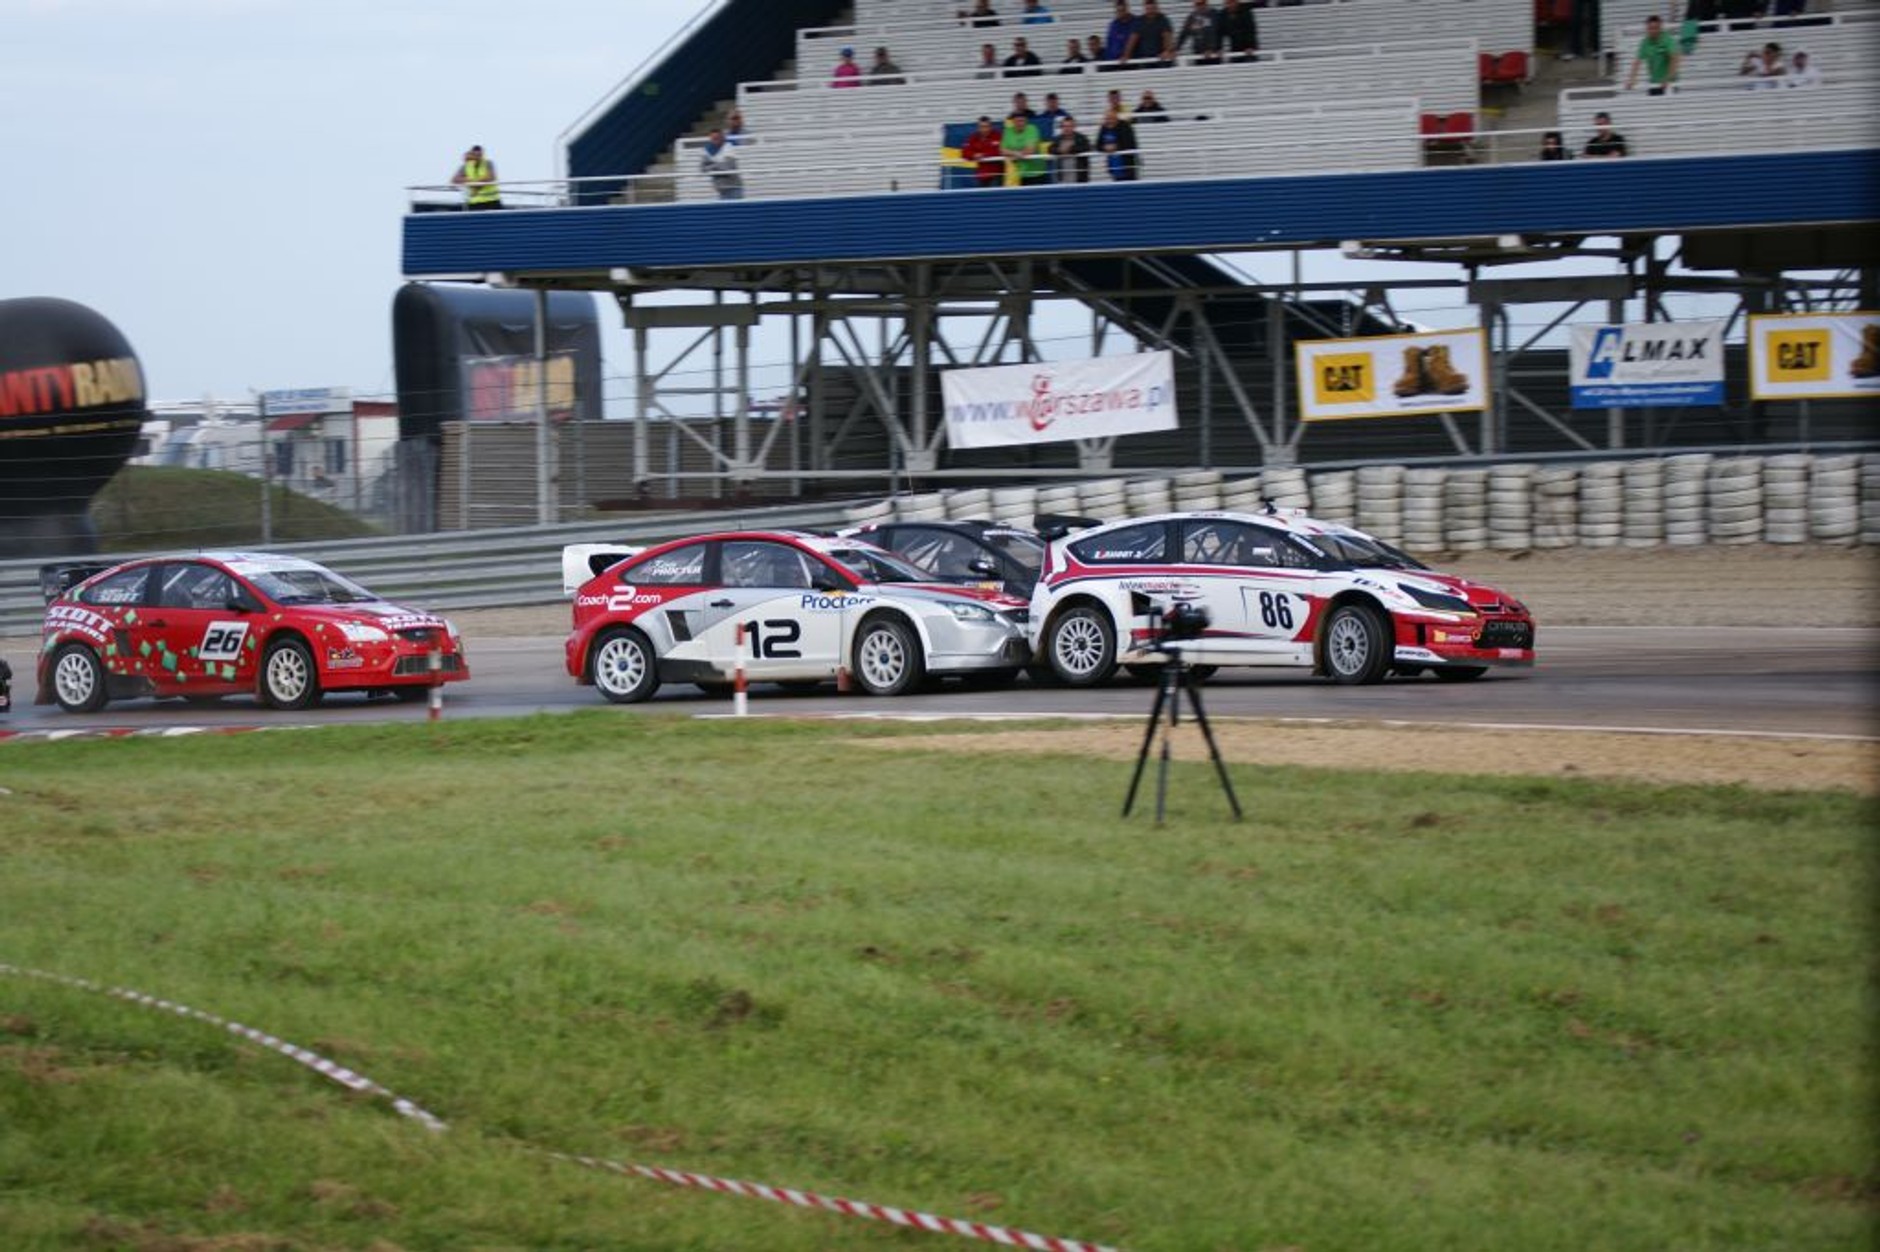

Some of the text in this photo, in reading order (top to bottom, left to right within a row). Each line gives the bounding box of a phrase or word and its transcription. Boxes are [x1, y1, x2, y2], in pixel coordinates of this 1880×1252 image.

[1777, 341, 1821, 370] CAT
[1324, 365, 1363, 392] CAT
[578, 585, 662, 611] Coach2.com
[1259, 591, 1294, 630] 86
[47, 605, 115, 633] SCOTT
[204, 629, 242, 654] 26
[743, 618, 802, 659] 12
